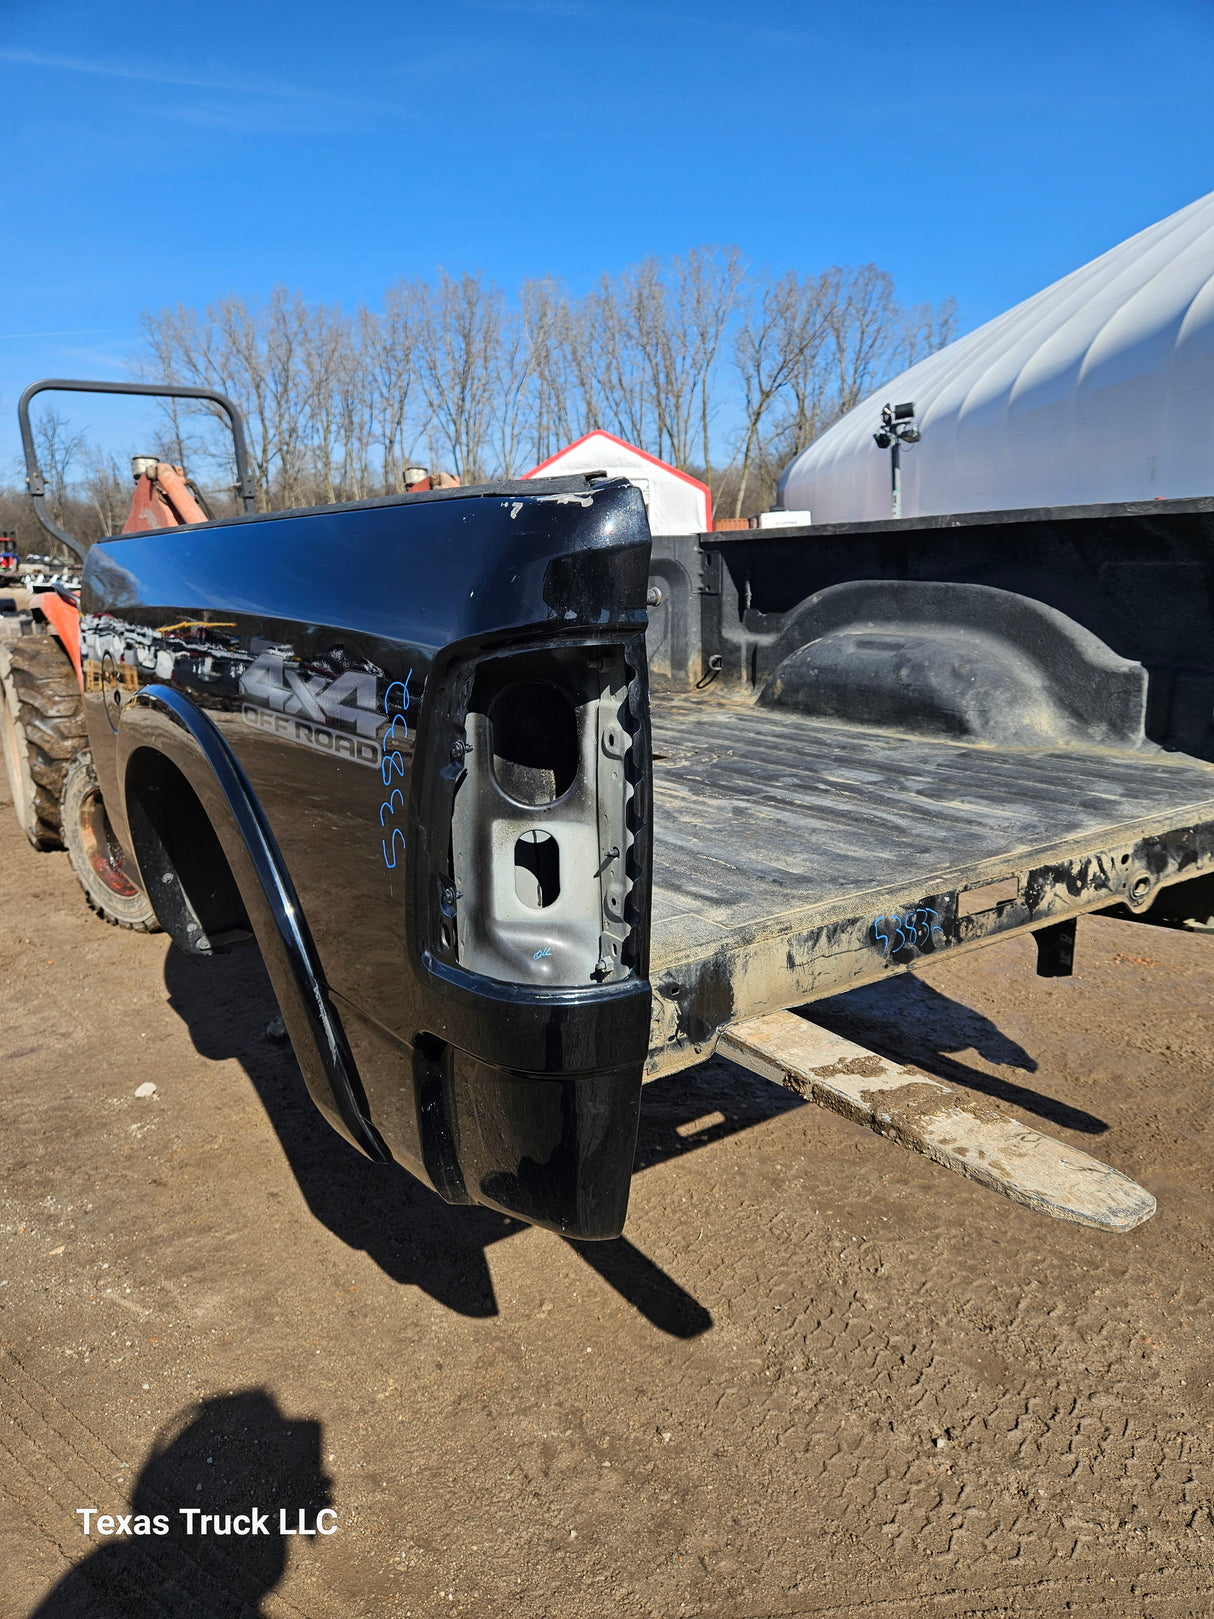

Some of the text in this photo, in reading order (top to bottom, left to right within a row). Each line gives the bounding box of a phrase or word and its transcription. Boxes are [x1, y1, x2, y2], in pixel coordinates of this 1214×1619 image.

[243, 706, 379, 764] OFF ROAD
[380, 668, 413, 868] 53832
[874, 907, 944, 956] 53832
